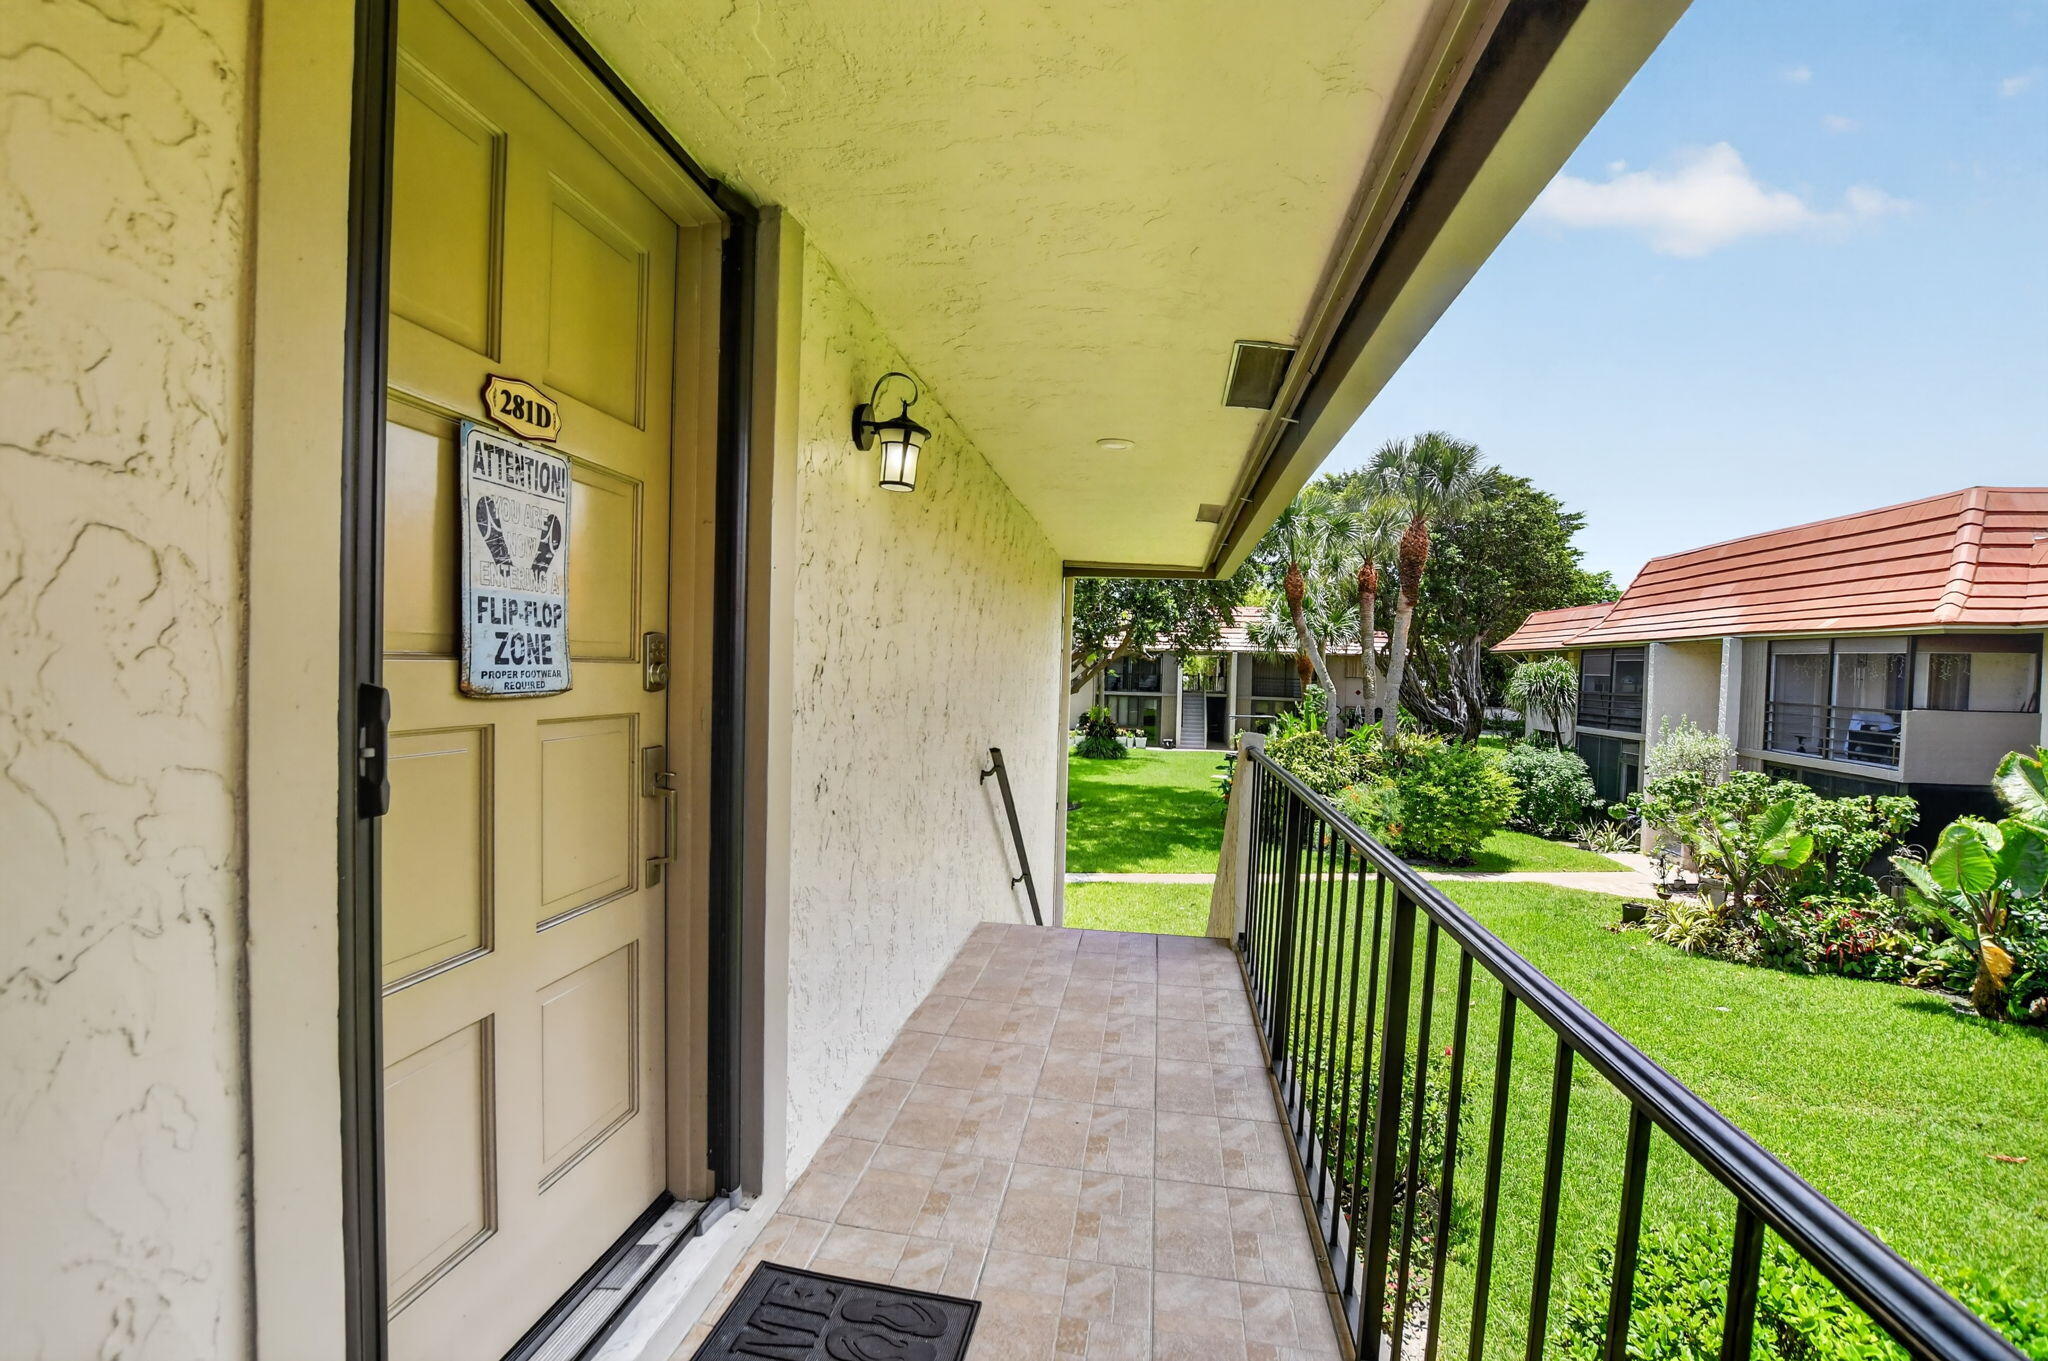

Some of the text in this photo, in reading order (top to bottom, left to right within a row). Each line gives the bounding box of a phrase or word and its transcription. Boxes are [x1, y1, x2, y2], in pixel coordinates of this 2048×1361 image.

[500, 389, 552, 428] 281D
[472, 440, 566, 498] ATTENTION!
[491, 495, 550, 532] YOU ARE
[480, 560, 547, 593] ENTERING
[477, 595, 562, 628] FLIP-FLOP
[494, 632, 553, 665] ZONE
[481, 669, 562, 680] PROPER FOOTWEAR
[503, 681, 546, 690] REQUIRED
